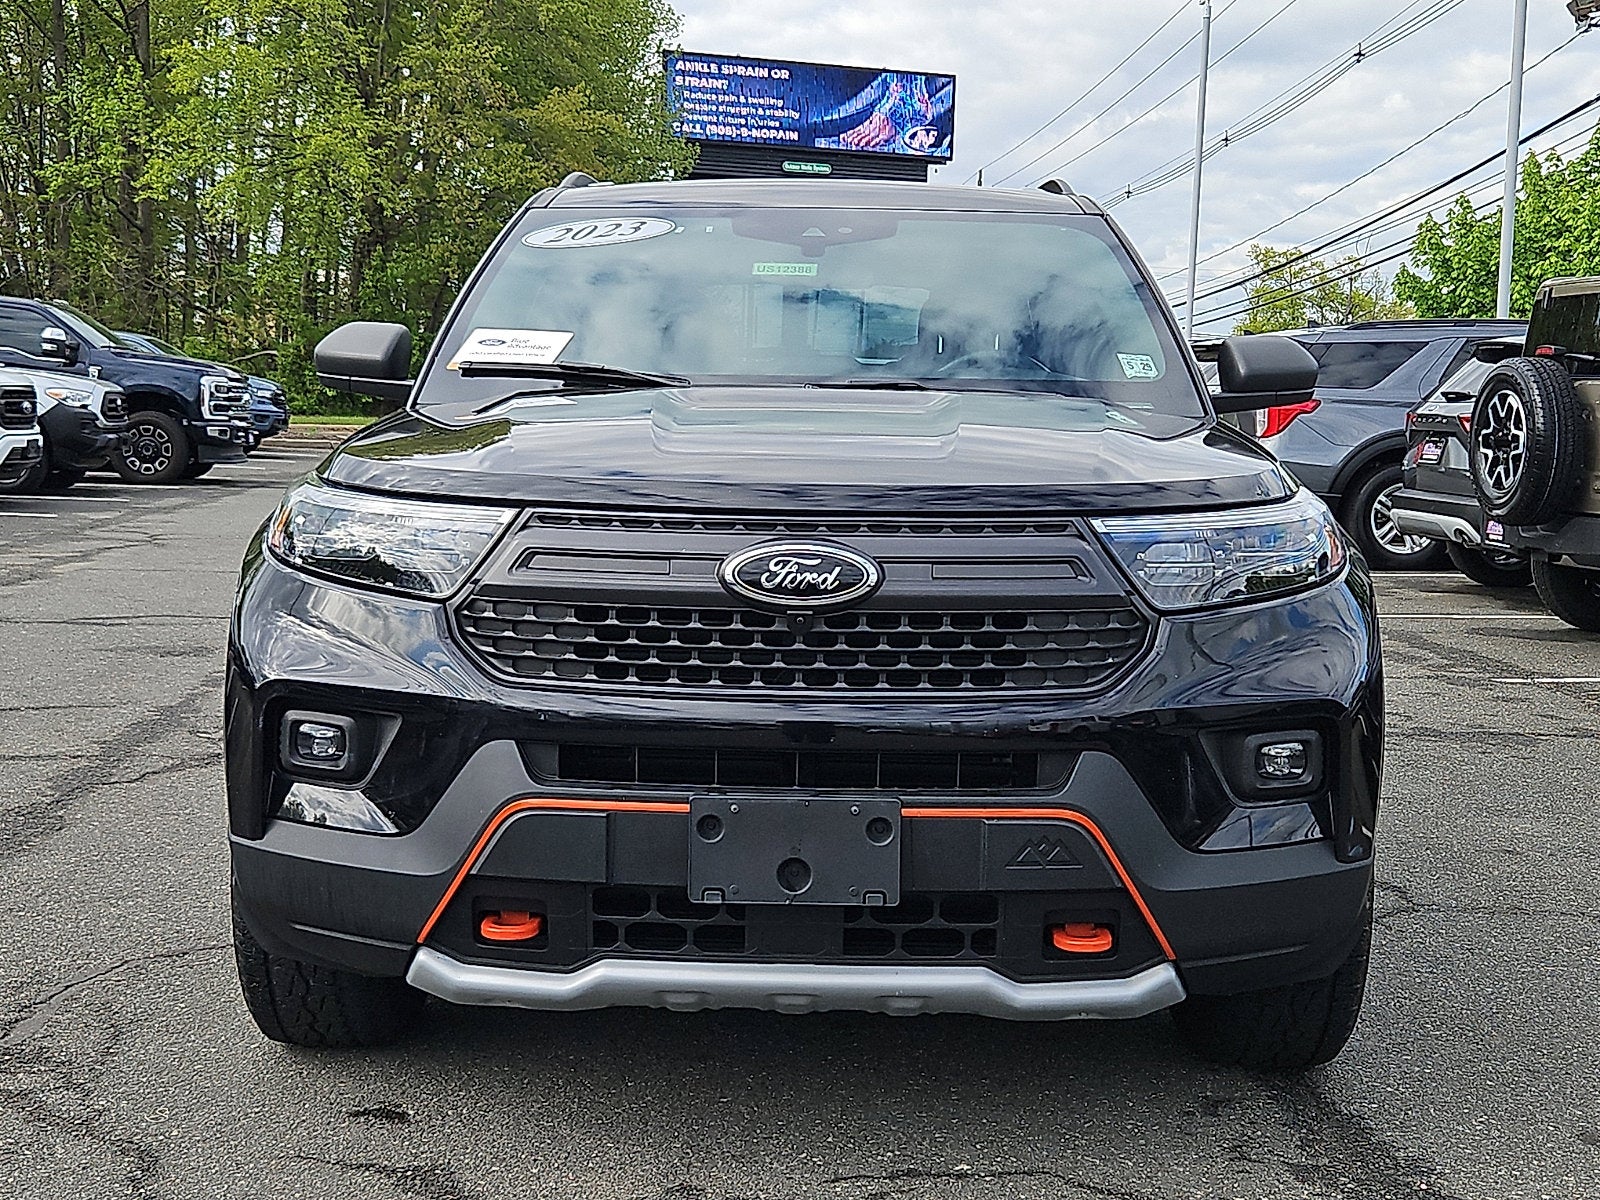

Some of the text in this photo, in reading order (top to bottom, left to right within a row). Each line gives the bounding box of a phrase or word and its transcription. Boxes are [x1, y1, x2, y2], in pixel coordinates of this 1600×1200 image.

[675, 60, 790, 80] ANKLE SPRAIN OR
[683, 90, 717, 101] Reduce
[718, 94, 738, 104] pain
[672, 121, 704, 134] CALL
[543, 221, 648, 244] 2023
[760, 556, 842, 590] Ford
